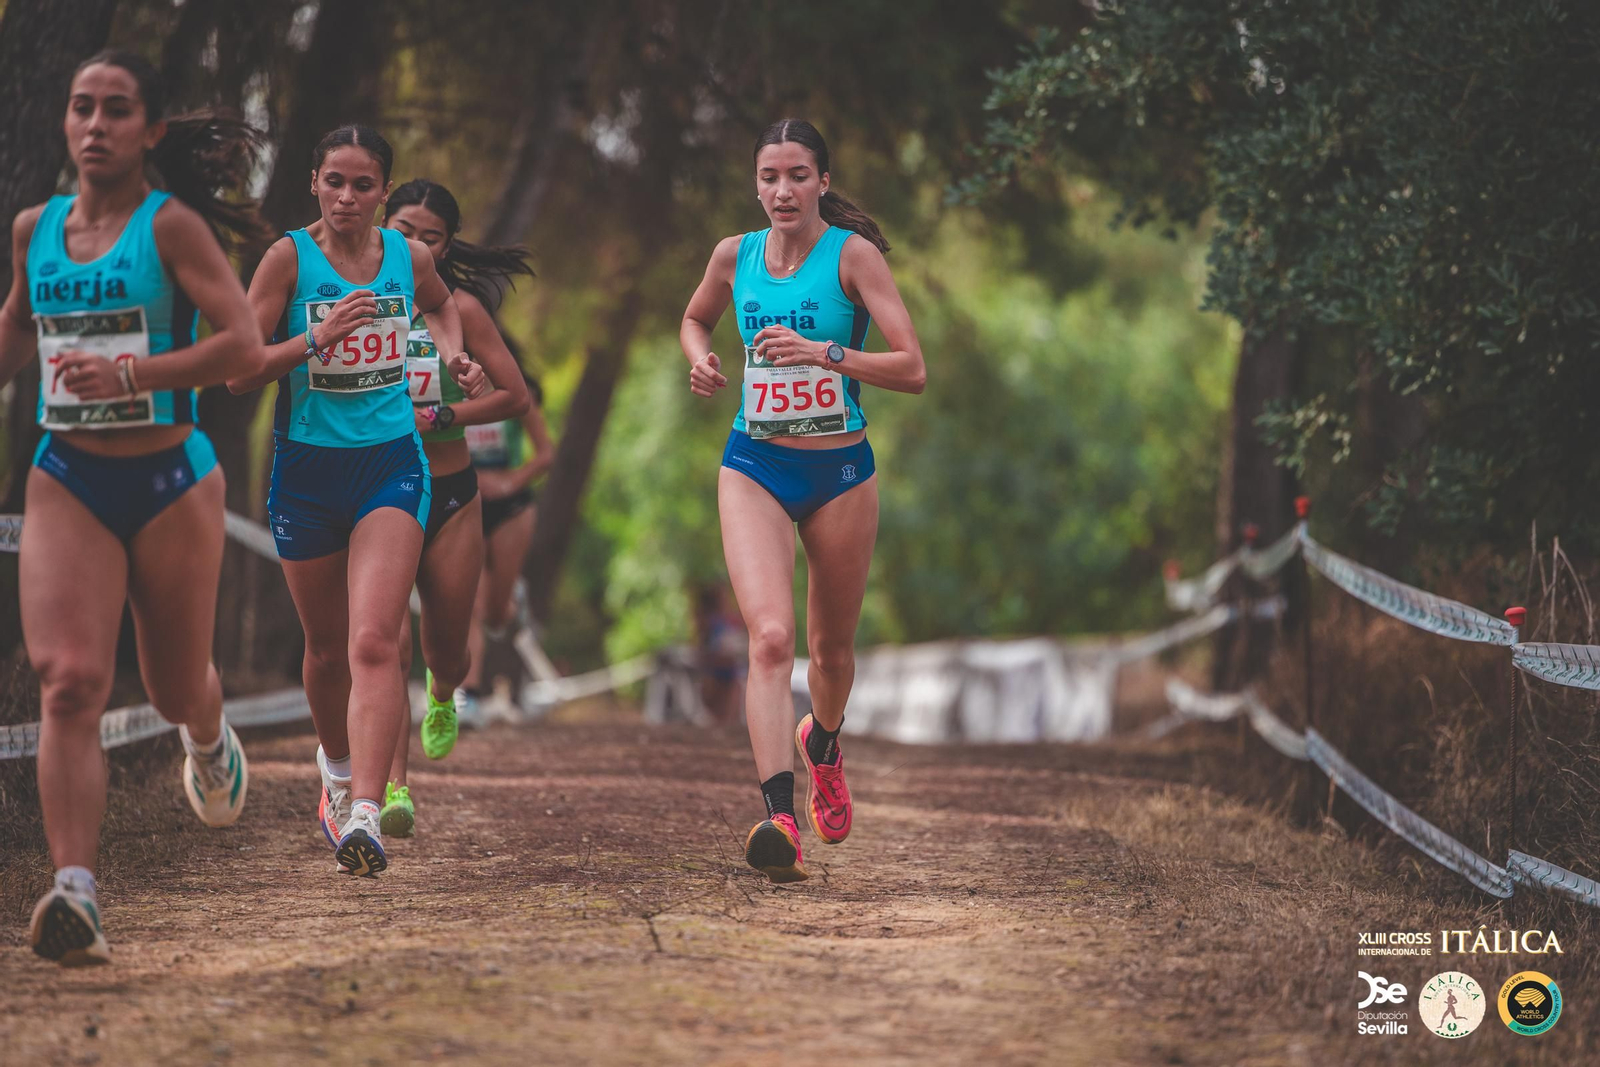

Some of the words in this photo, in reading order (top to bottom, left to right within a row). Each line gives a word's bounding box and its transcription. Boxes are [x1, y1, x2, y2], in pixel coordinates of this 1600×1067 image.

[36, 271, 128, 307] nerja
[319, 285, 340, 295] TROPS
[744, 310, 817, 332] nerja
[405, 371, 432, 396] 7
[752, 377, 837, 413] 7556
